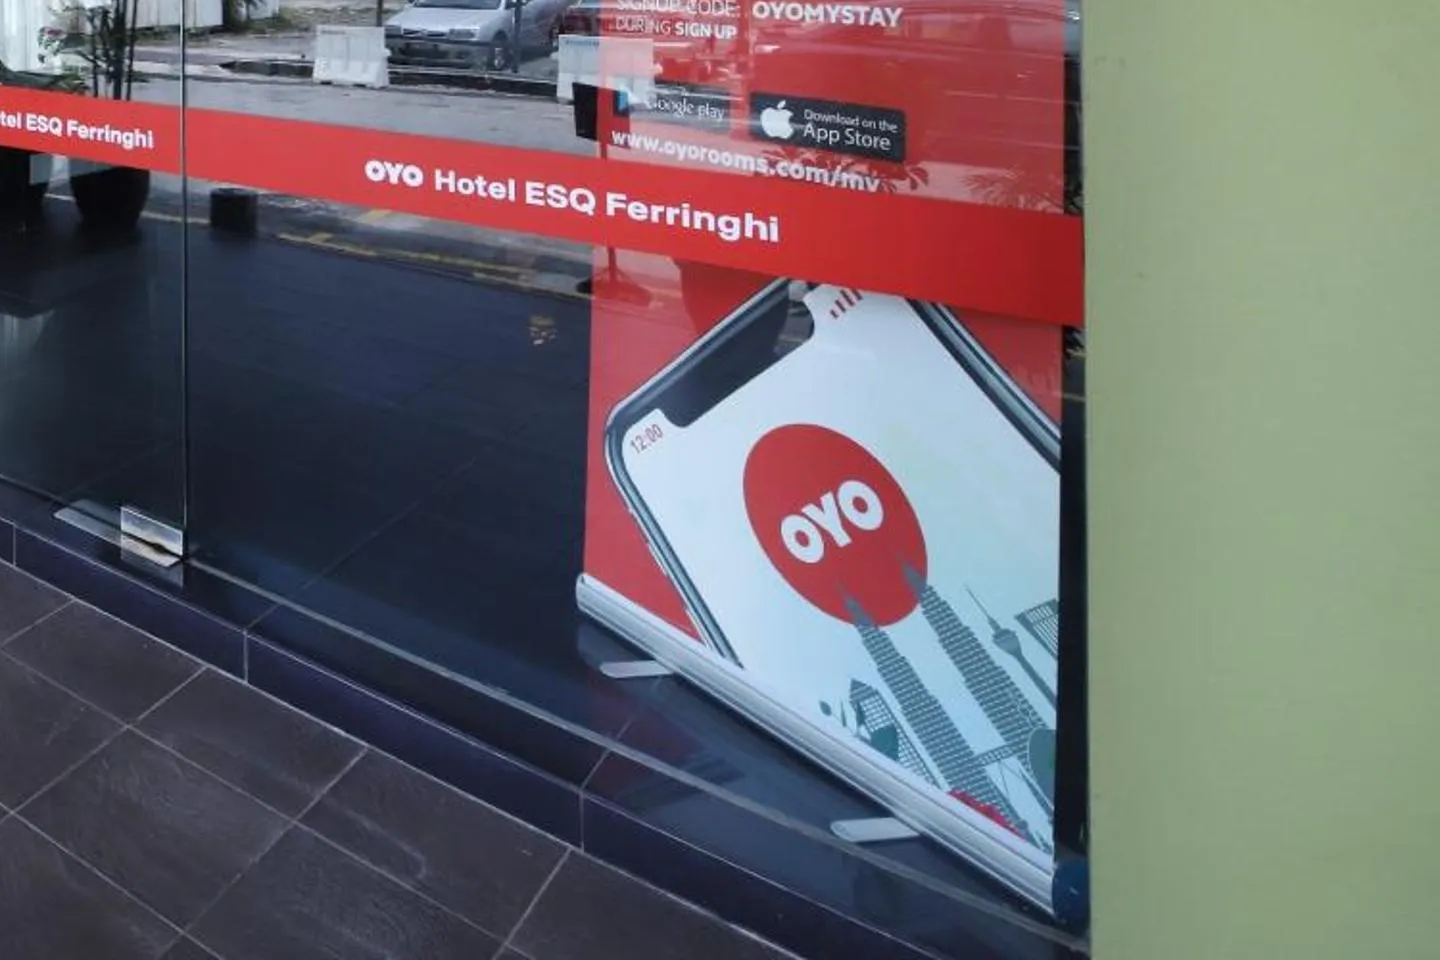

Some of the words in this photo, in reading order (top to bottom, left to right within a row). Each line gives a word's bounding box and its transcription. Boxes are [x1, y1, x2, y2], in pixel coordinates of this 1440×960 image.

[751, 0, 904, 28] OYOMYSTAY
[698, 102, 725, 123] play
[804, 108, 860, 127] Download
[861, 119, 876, 129] on
[878, 119, 898, 133] the
[26, 113, 62, 137] ESQ
[66, 119, 154, 149] Ferringhi
[803, 125, 840, 145] App
[843, 126, 892, 151] Store
[364, 159, 424, 188] OYO
[433, 169, 516, 202] Hotel
[524, 181, 597, 216] ESQ
[605, 191, 780, 243] Ferringhi
[629, 423, 663, 454] 12:00
[780, 479, 885, 564] OYO
